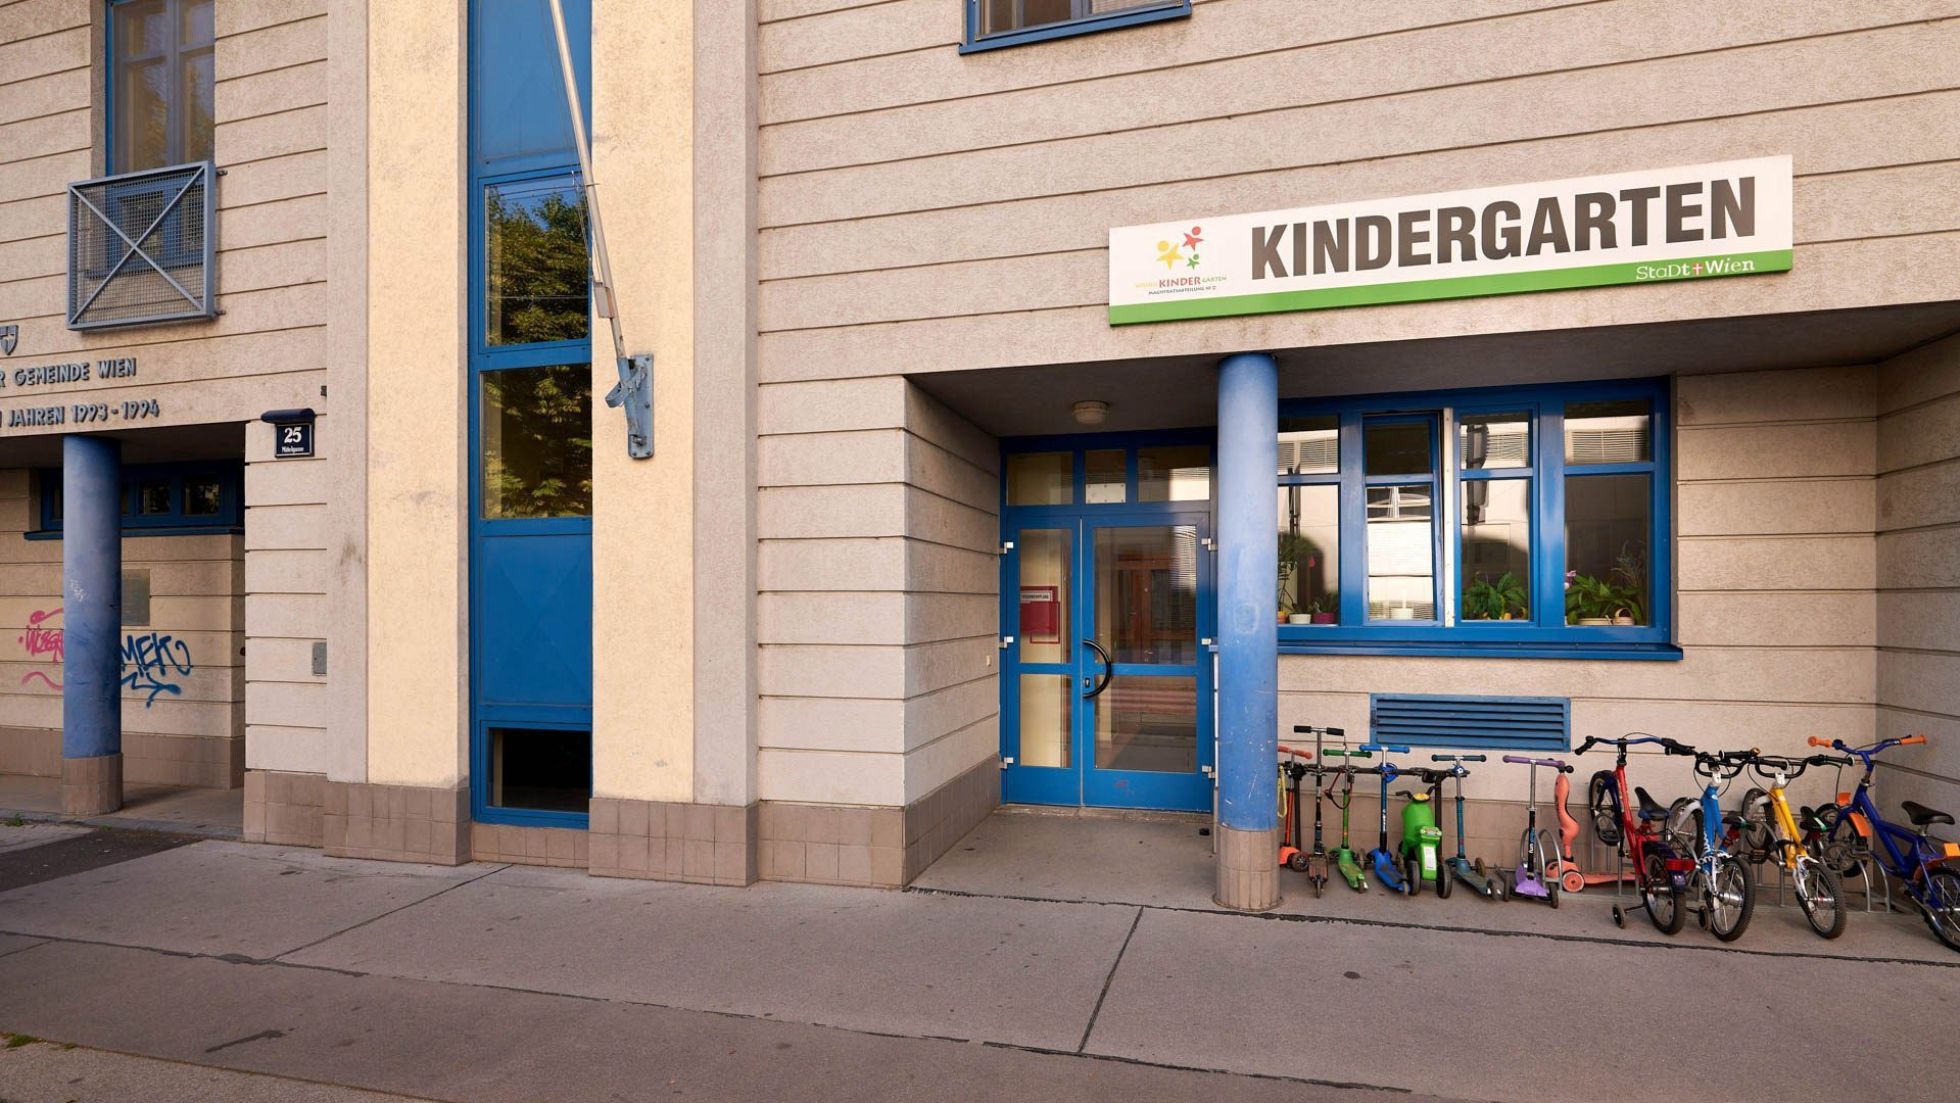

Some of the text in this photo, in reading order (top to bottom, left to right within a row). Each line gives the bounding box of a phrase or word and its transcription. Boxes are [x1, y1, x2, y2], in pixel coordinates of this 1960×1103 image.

[1252, 176, 1755, 280] KINDERGARTEN
[1704, 258, 1755, 275] Wien
[1159, 276, 1201, 288] KINDER
[14, 362, 90, 387] GEMEINDE
[97, 357, 137, 379] WIEN
[8, 405, 65, 427] JAHREN
[71, 403, 108, 424] 1993
[121, 399, 160, 420] 1994
[284, 426, 302, 443] 25
